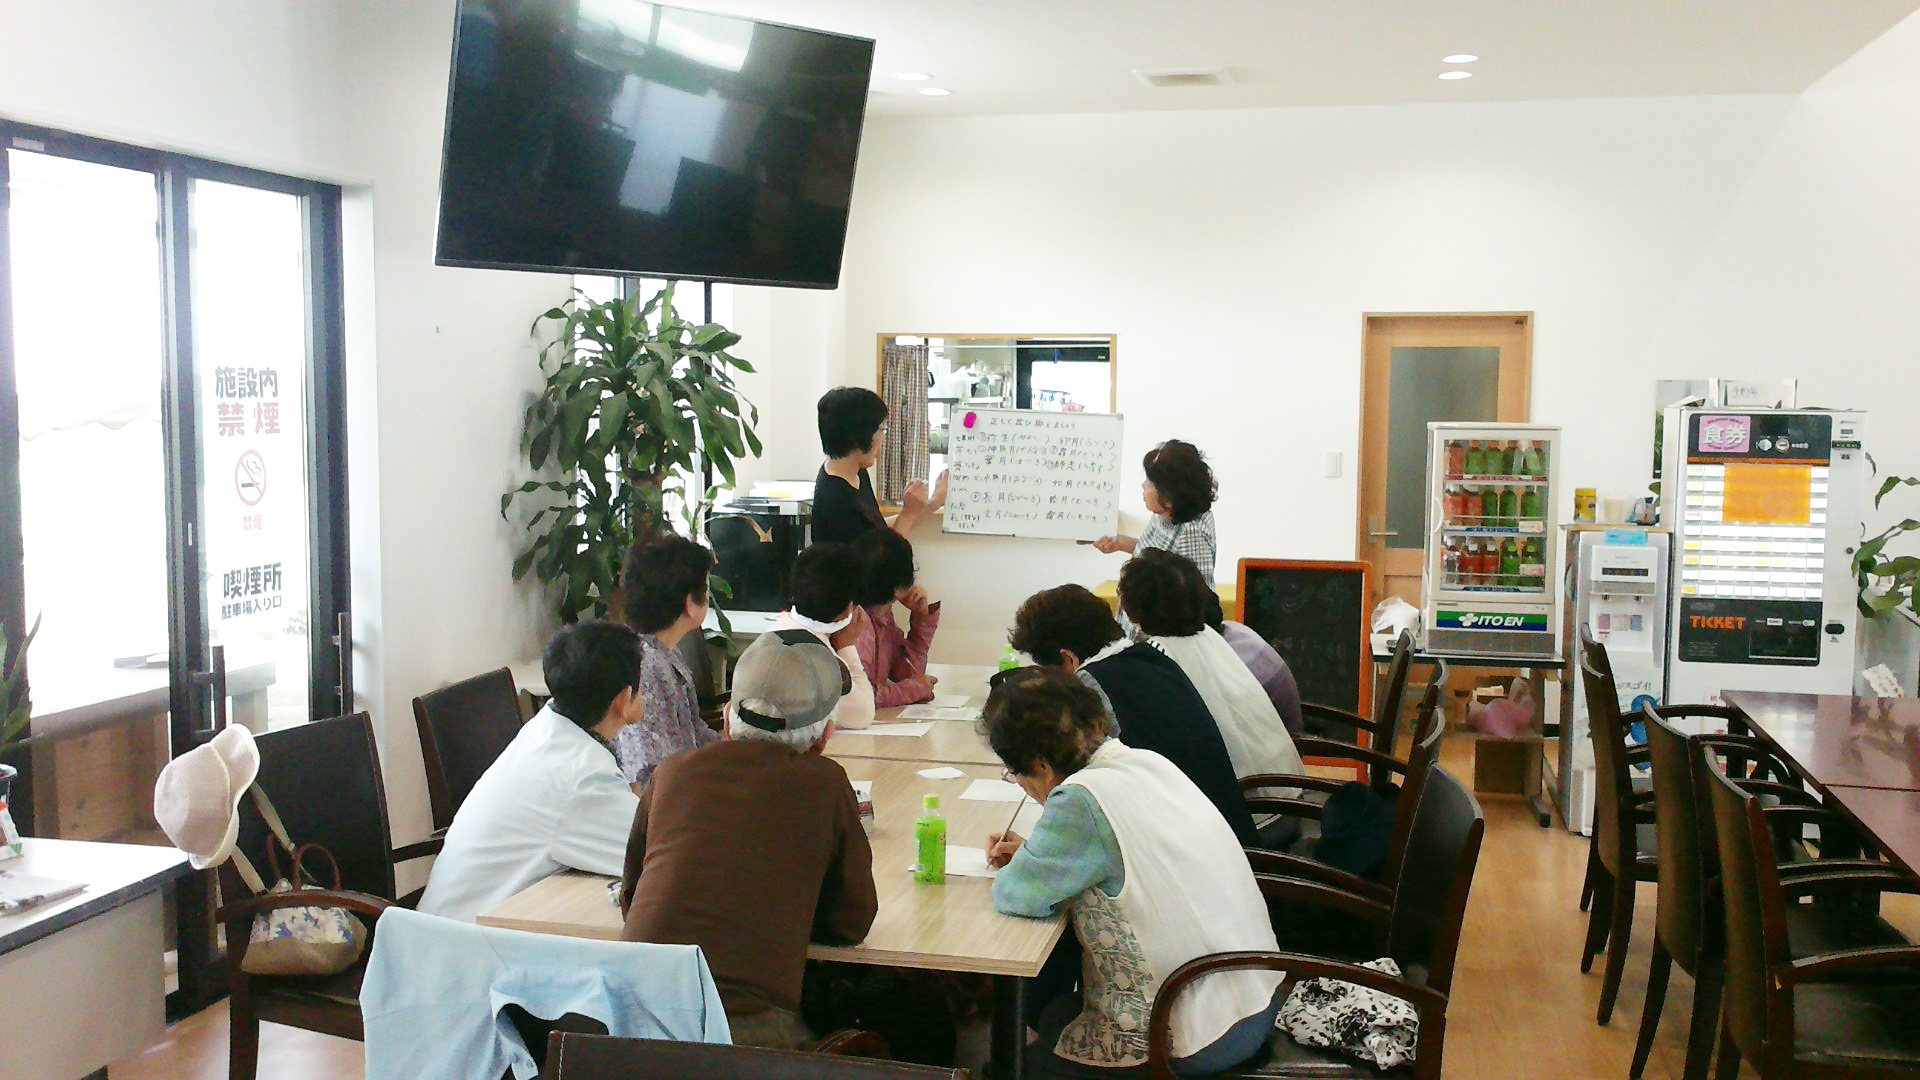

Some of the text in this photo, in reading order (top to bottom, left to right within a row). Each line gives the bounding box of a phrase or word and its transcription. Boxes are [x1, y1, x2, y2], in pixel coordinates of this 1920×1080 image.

[215, 366, 278, 398] 施設内
[217, 402, 280, 437] 禁煙
[1703, 424, 1747, 446] 食券
[223, 562, 282, 599] 喫煙所
[221, 595, 282, 620] 駐車場入り口
[1689, 615, 1747, 631] TICKET
